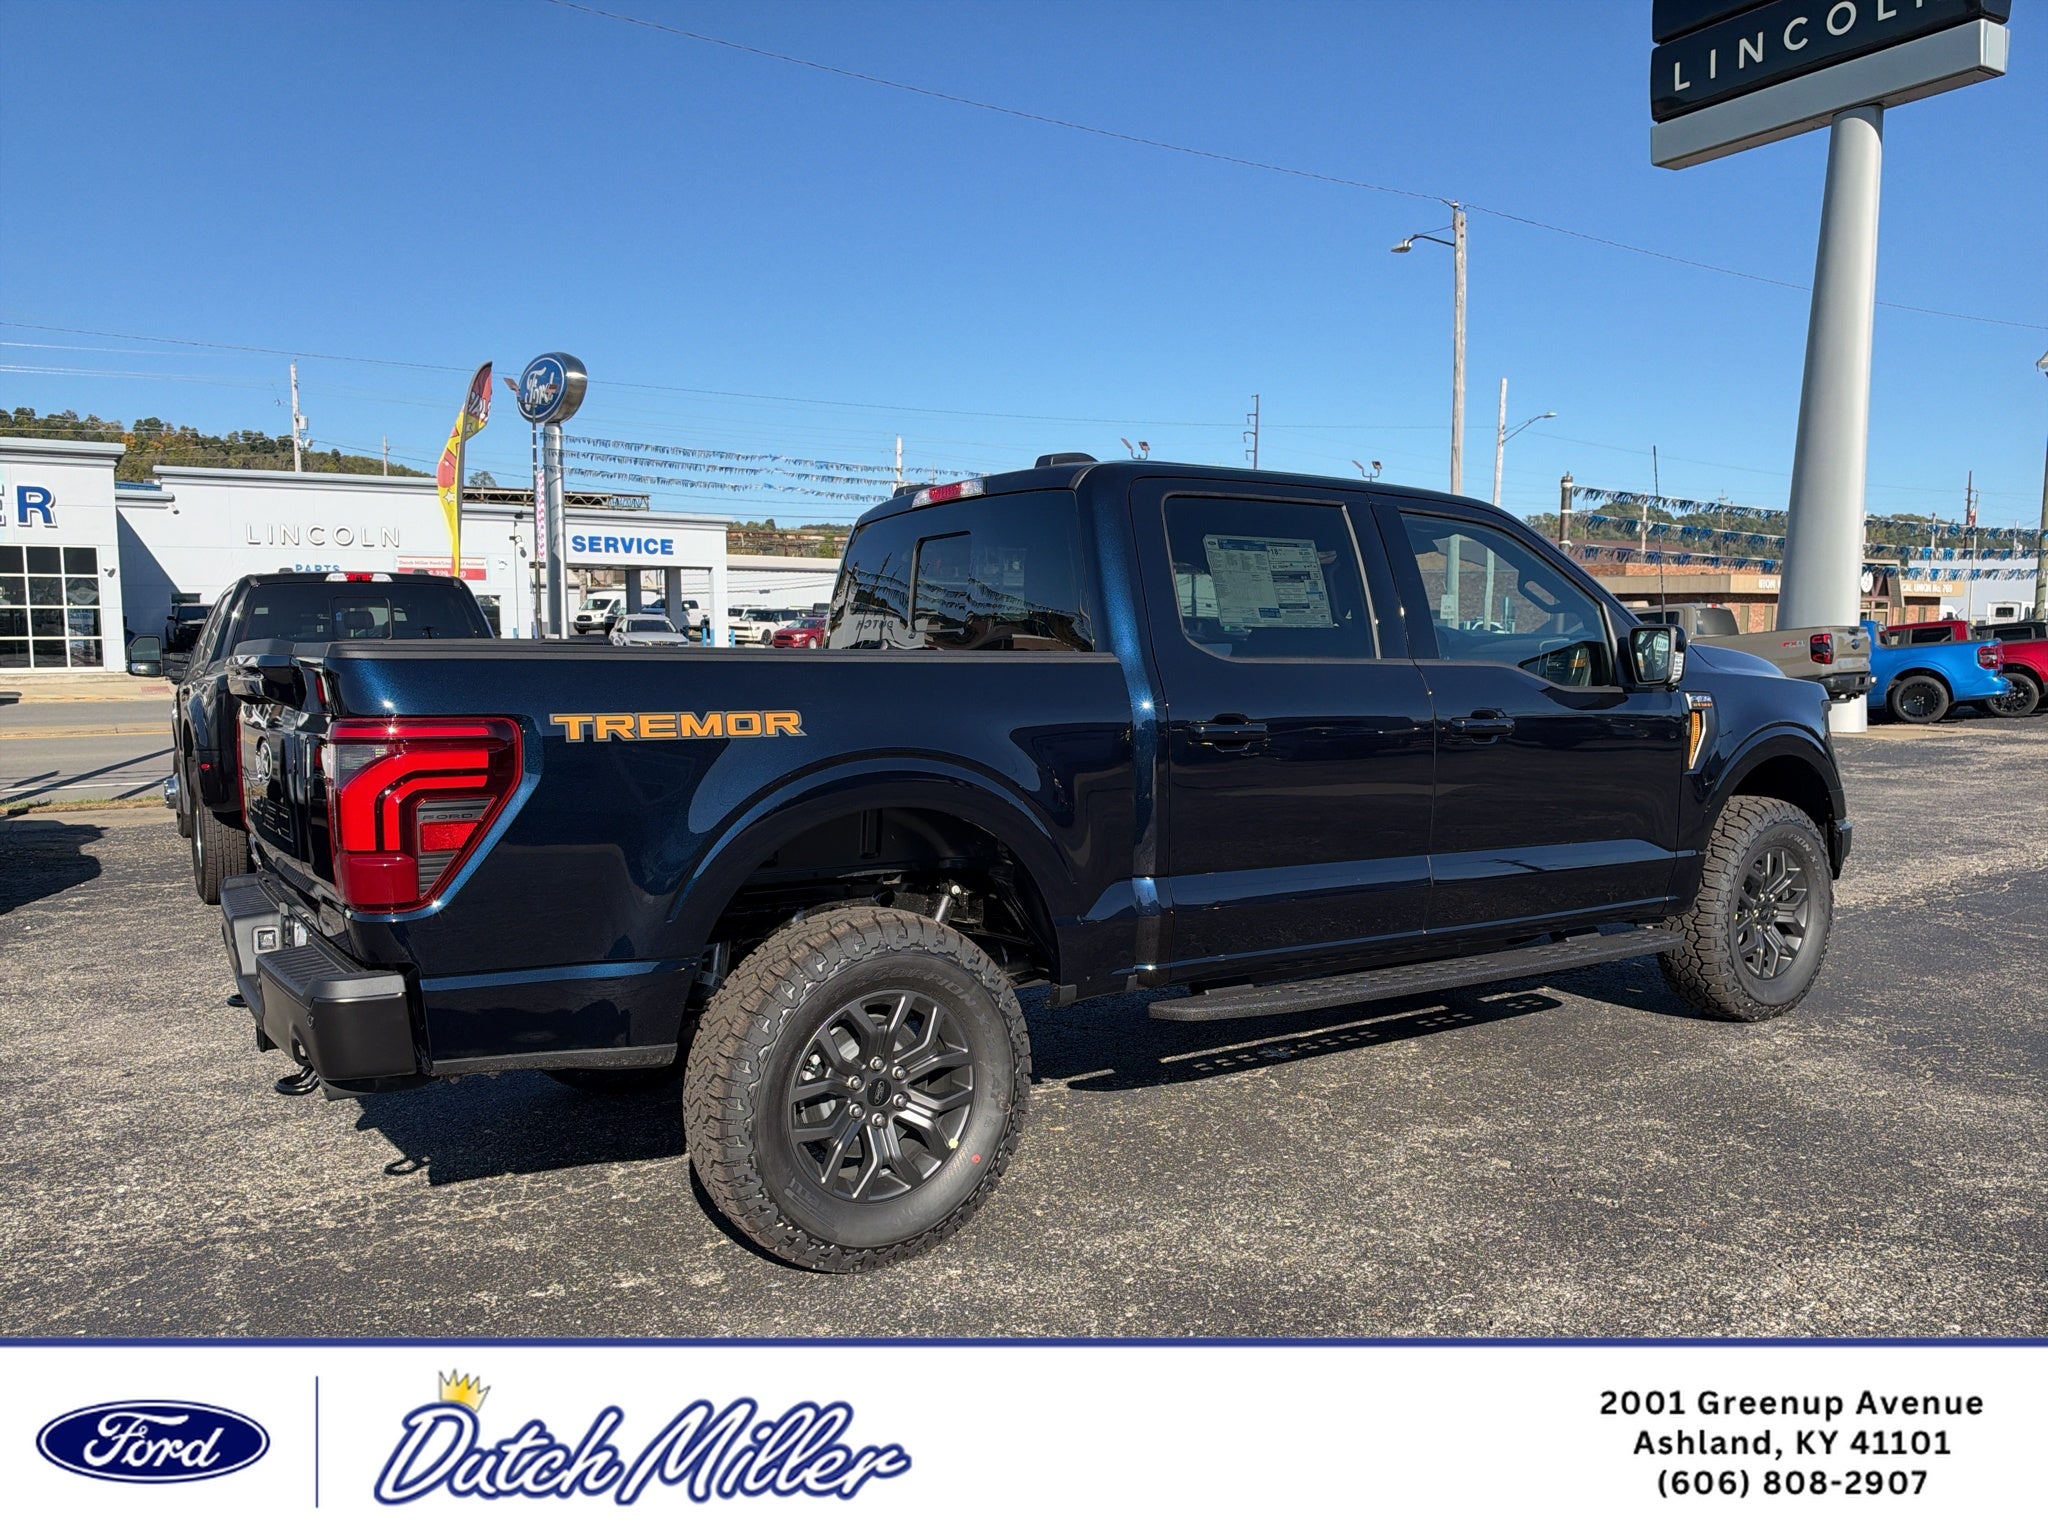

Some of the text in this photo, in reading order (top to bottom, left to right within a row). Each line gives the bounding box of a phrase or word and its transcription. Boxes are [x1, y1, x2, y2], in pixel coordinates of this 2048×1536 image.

[1673, 0, 1923, 91] LINCOL
[0, 485, 58, 528] R
[246, 524, 400, 548] LINCOLN
[571, 535, 674, 555] SERVICE
[295, 564, 341, 572] PARTS
[550, 710, 807, 742] TREMOR
